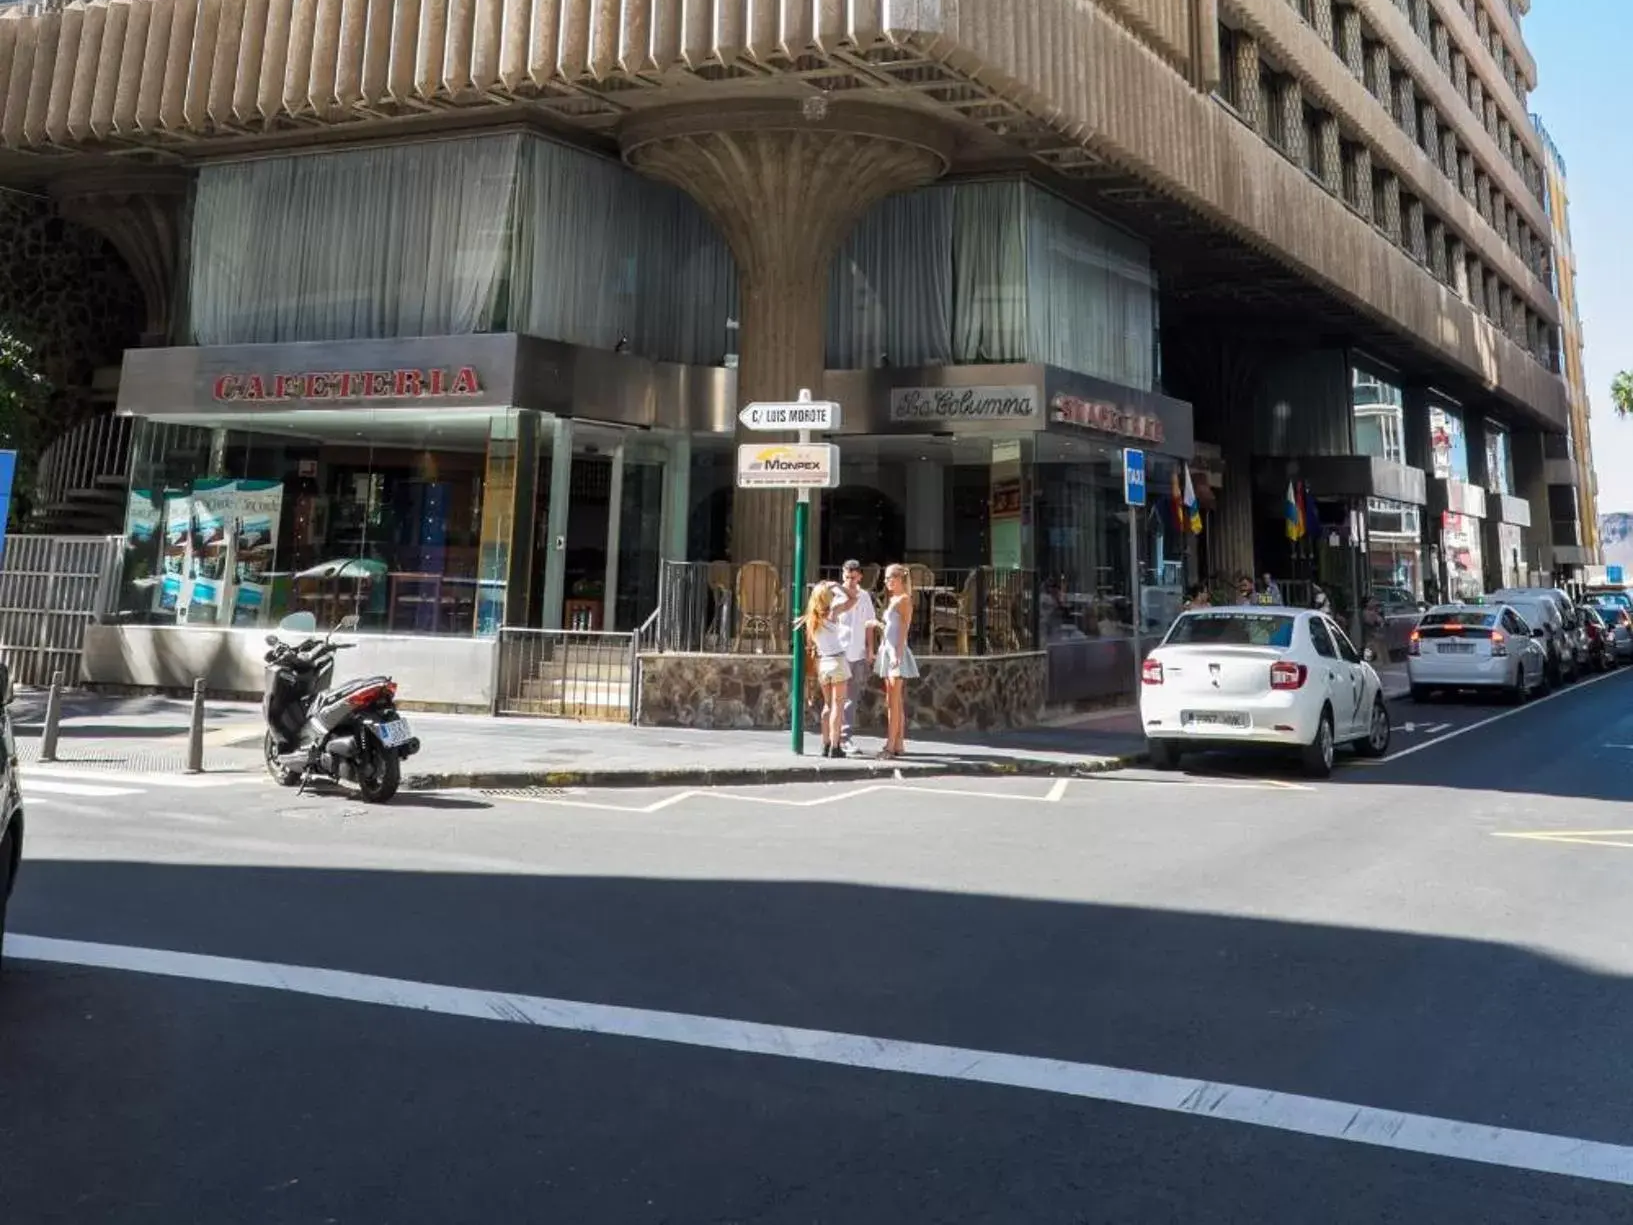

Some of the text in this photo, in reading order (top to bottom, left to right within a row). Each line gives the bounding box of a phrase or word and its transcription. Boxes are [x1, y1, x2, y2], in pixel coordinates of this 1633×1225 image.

[212, 366, 481, 401] CAFETERIA
[767, 409, 786, 423] LUIS
[788, 409, 827, 423] MOROTE
[934, 388, 1033, 417] Columna
